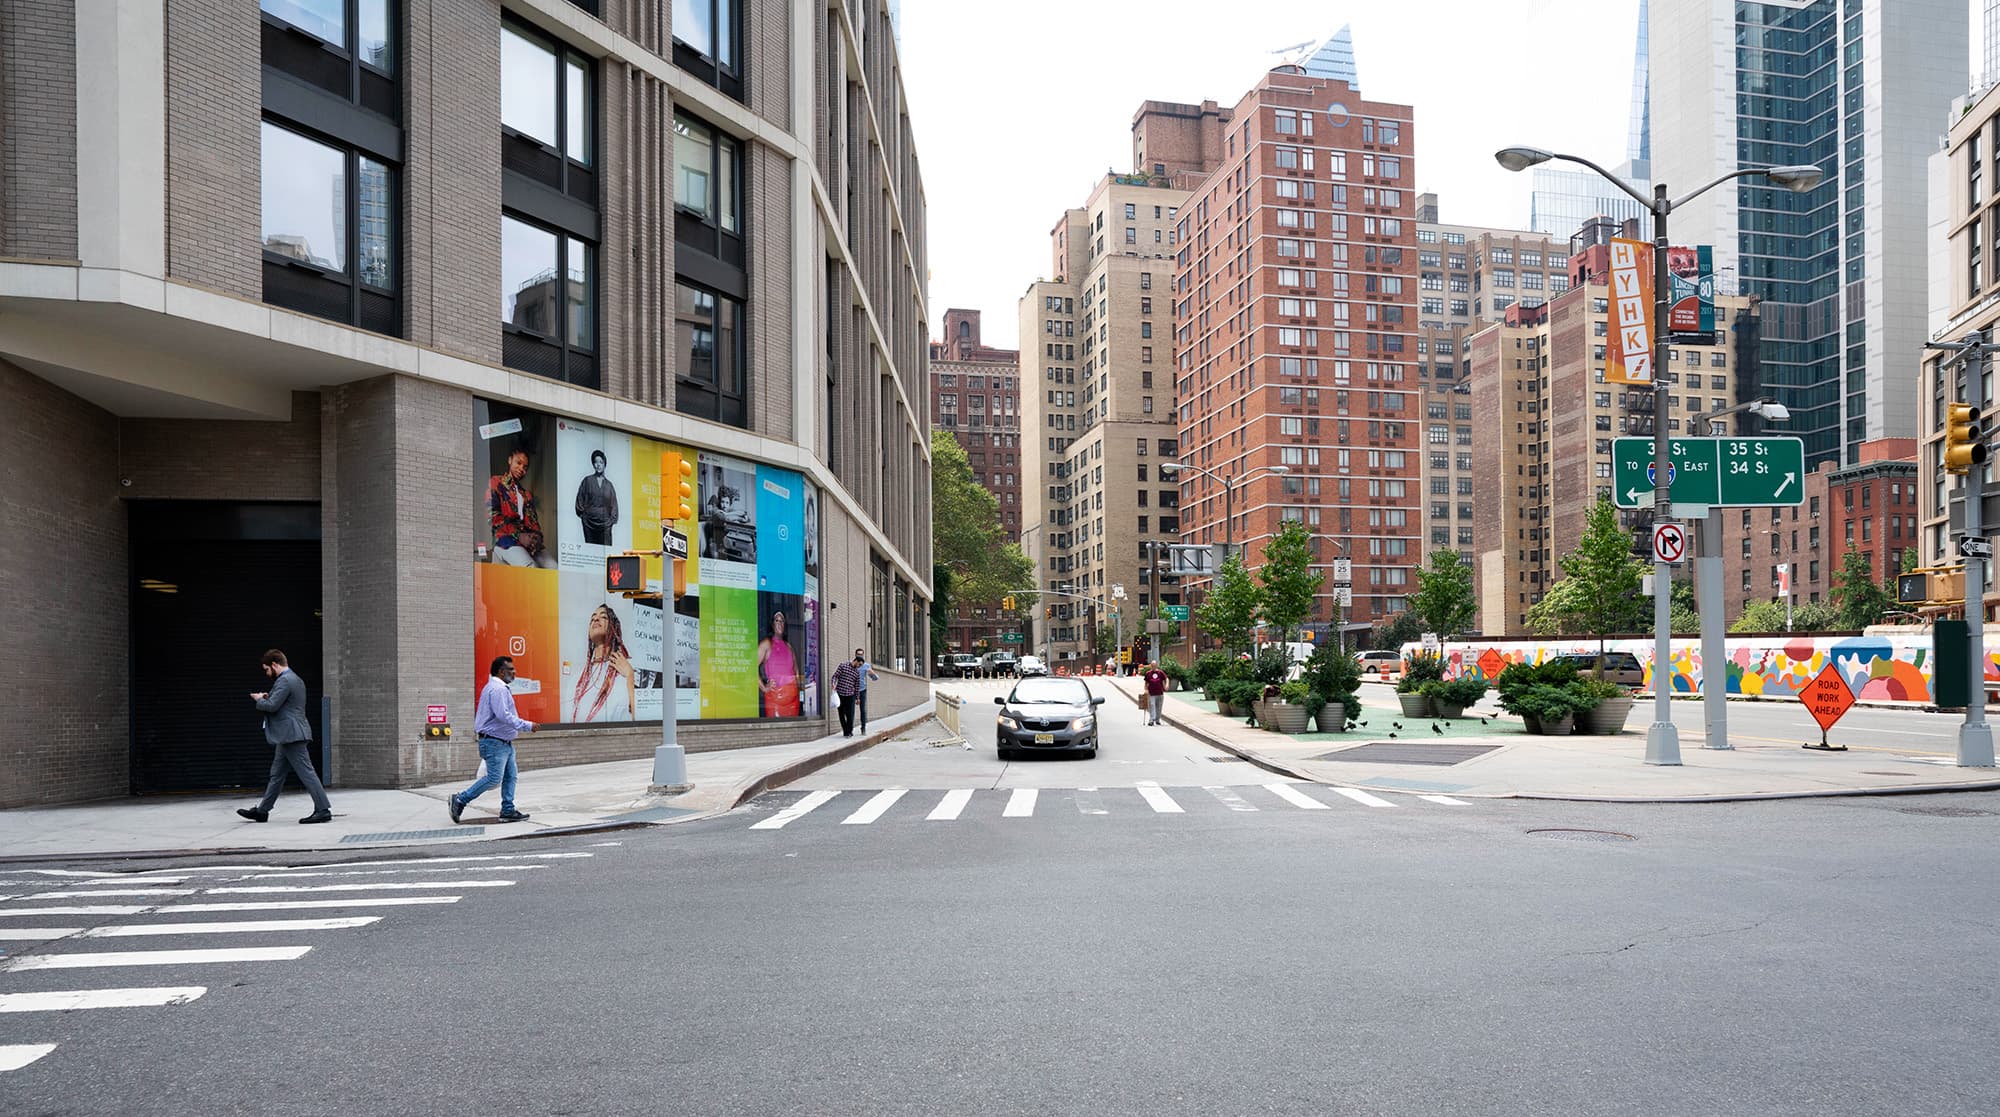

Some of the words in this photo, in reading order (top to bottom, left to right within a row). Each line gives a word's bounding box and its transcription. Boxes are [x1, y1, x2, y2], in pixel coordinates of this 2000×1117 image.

[1700, 281, 1712, 297] 80
[1700, 307, 1713, 315] 2017
[1672, 442, 1687, 456] St
[1729, 442, 1748, 456] 35
[1754, 442, 1769, 456] St
[1626, 462, 1639, 471] TO
[1684, 461, 1709, 472] EAST
[1730, 461, 1749, 475] 34
[1755, 461, 1769, 474] St
[664, 535, 674, 548] ONE
[1965, 542, 1979, 552] ONE
[1818, 680, 1840, 690] ROAD
[1817, 693, 1840, 703] WORK
[1814, 705, 1841, 716] AHEAD
